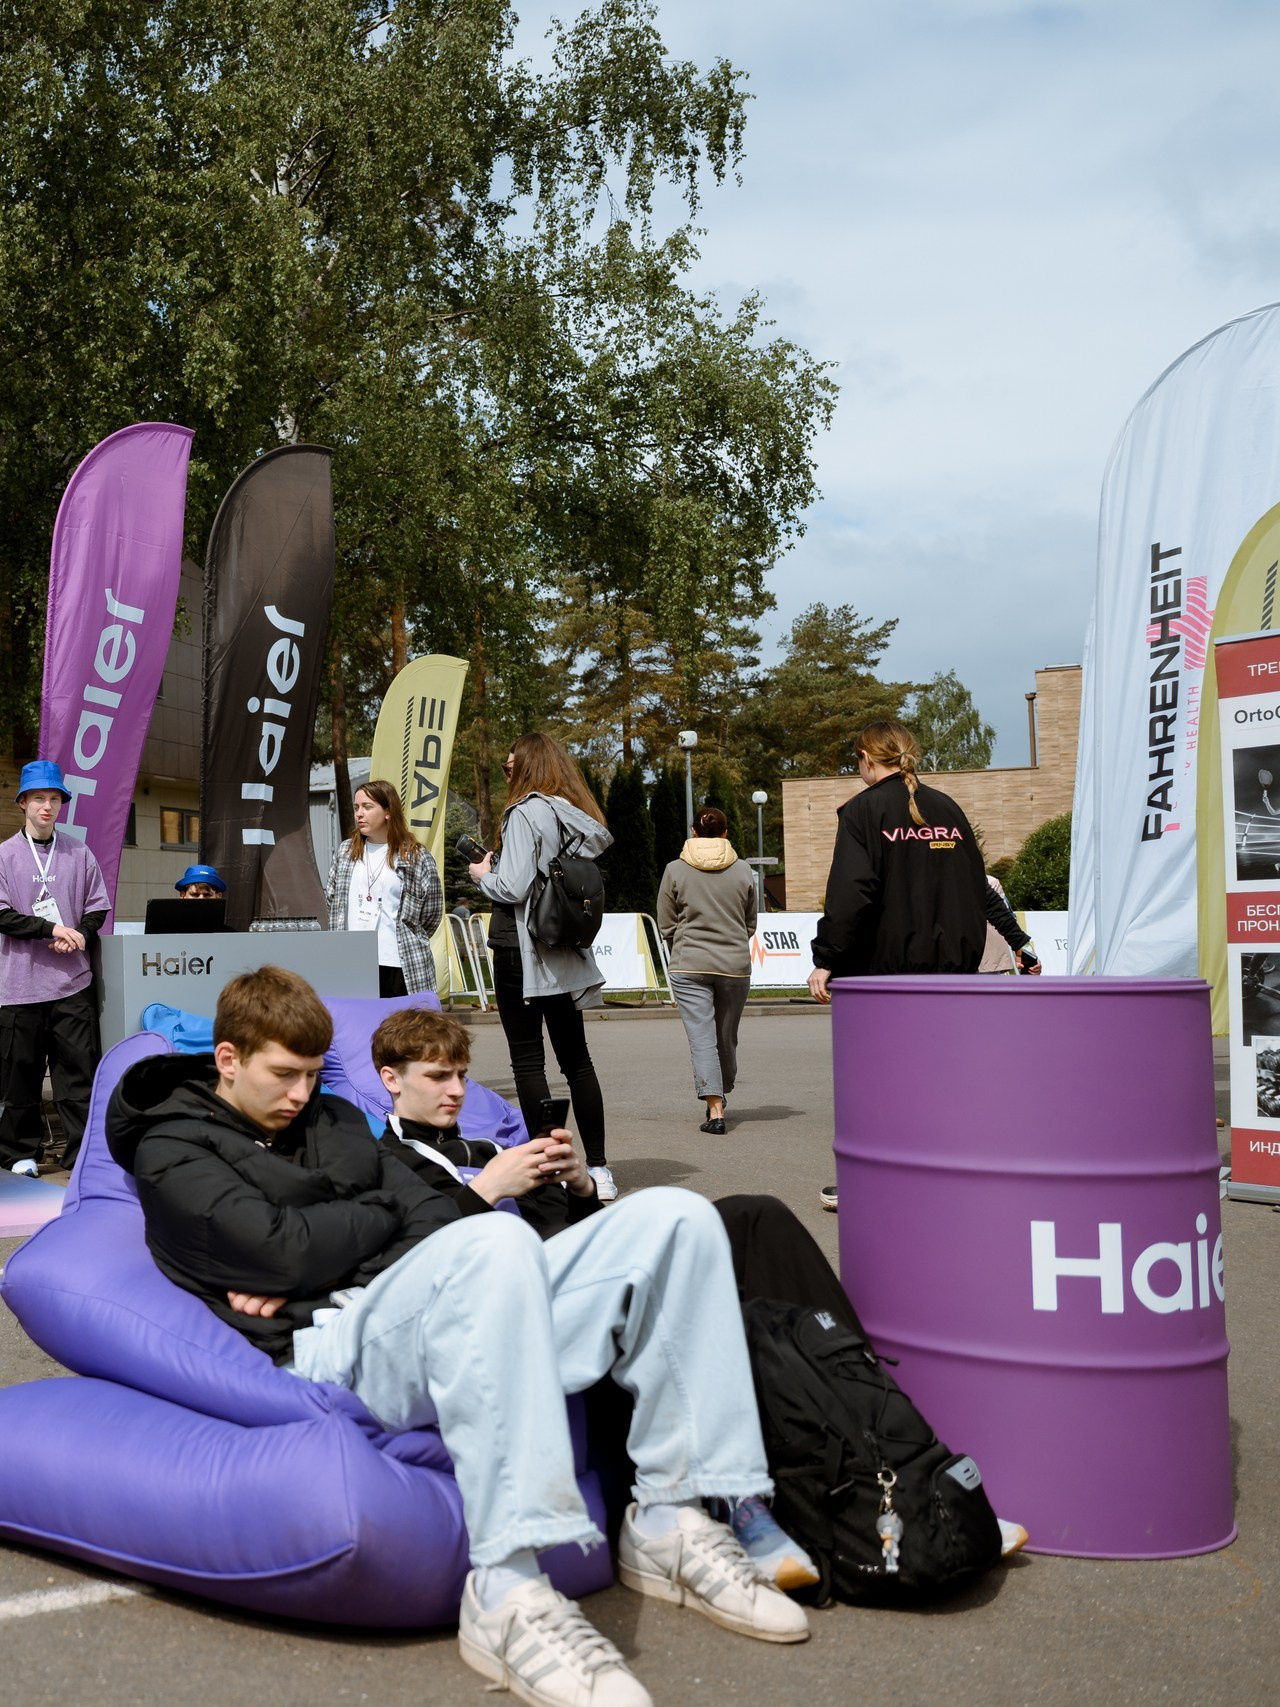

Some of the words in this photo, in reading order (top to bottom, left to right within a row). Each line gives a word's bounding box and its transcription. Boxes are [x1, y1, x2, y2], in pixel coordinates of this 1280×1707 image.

[1247, 661, 1280, 677] ТРЕ
[1141, 542, 1182, 842] FAHRENHEIT
[56, 588, 145, 844] Haier
[1186, 685, 1200, 751] HEALTH
[882, 826, 964, 842] VIAGRA
[32, 874, 57, 883] Haer
[1237, 919, 1280, 932] ПРОН
[762, 931, 800, 950] STAR
[142, 950, 214, 977] Haier
